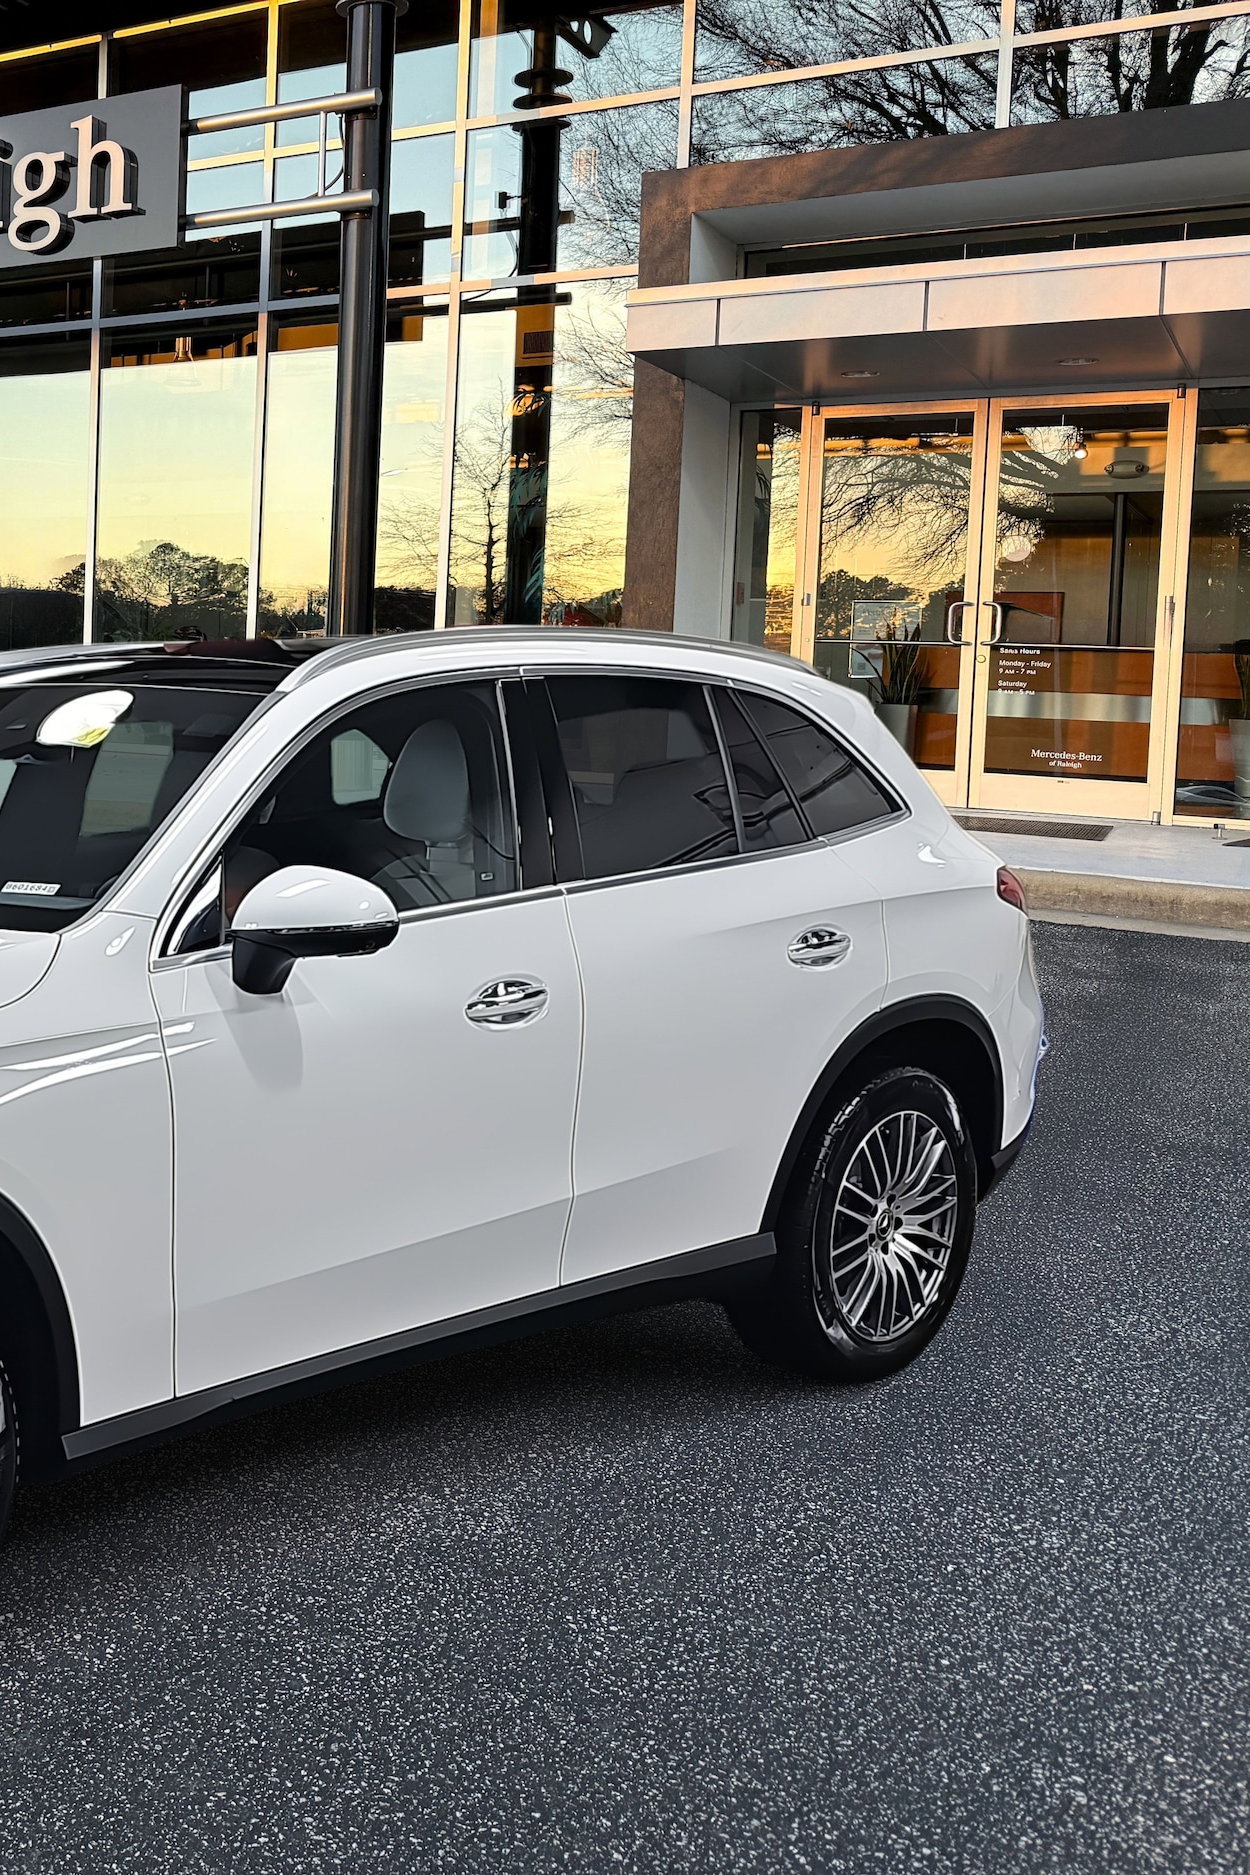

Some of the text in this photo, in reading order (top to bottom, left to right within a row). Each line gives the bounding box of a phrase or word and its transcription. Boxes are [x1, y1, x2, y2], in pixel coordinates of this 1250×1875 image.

[998, 680, 1027, 688] Saturday
[1031, 749, 1102, 761] Mercedes-Benz
[1057, 761, 1082, 769] Raleigh
